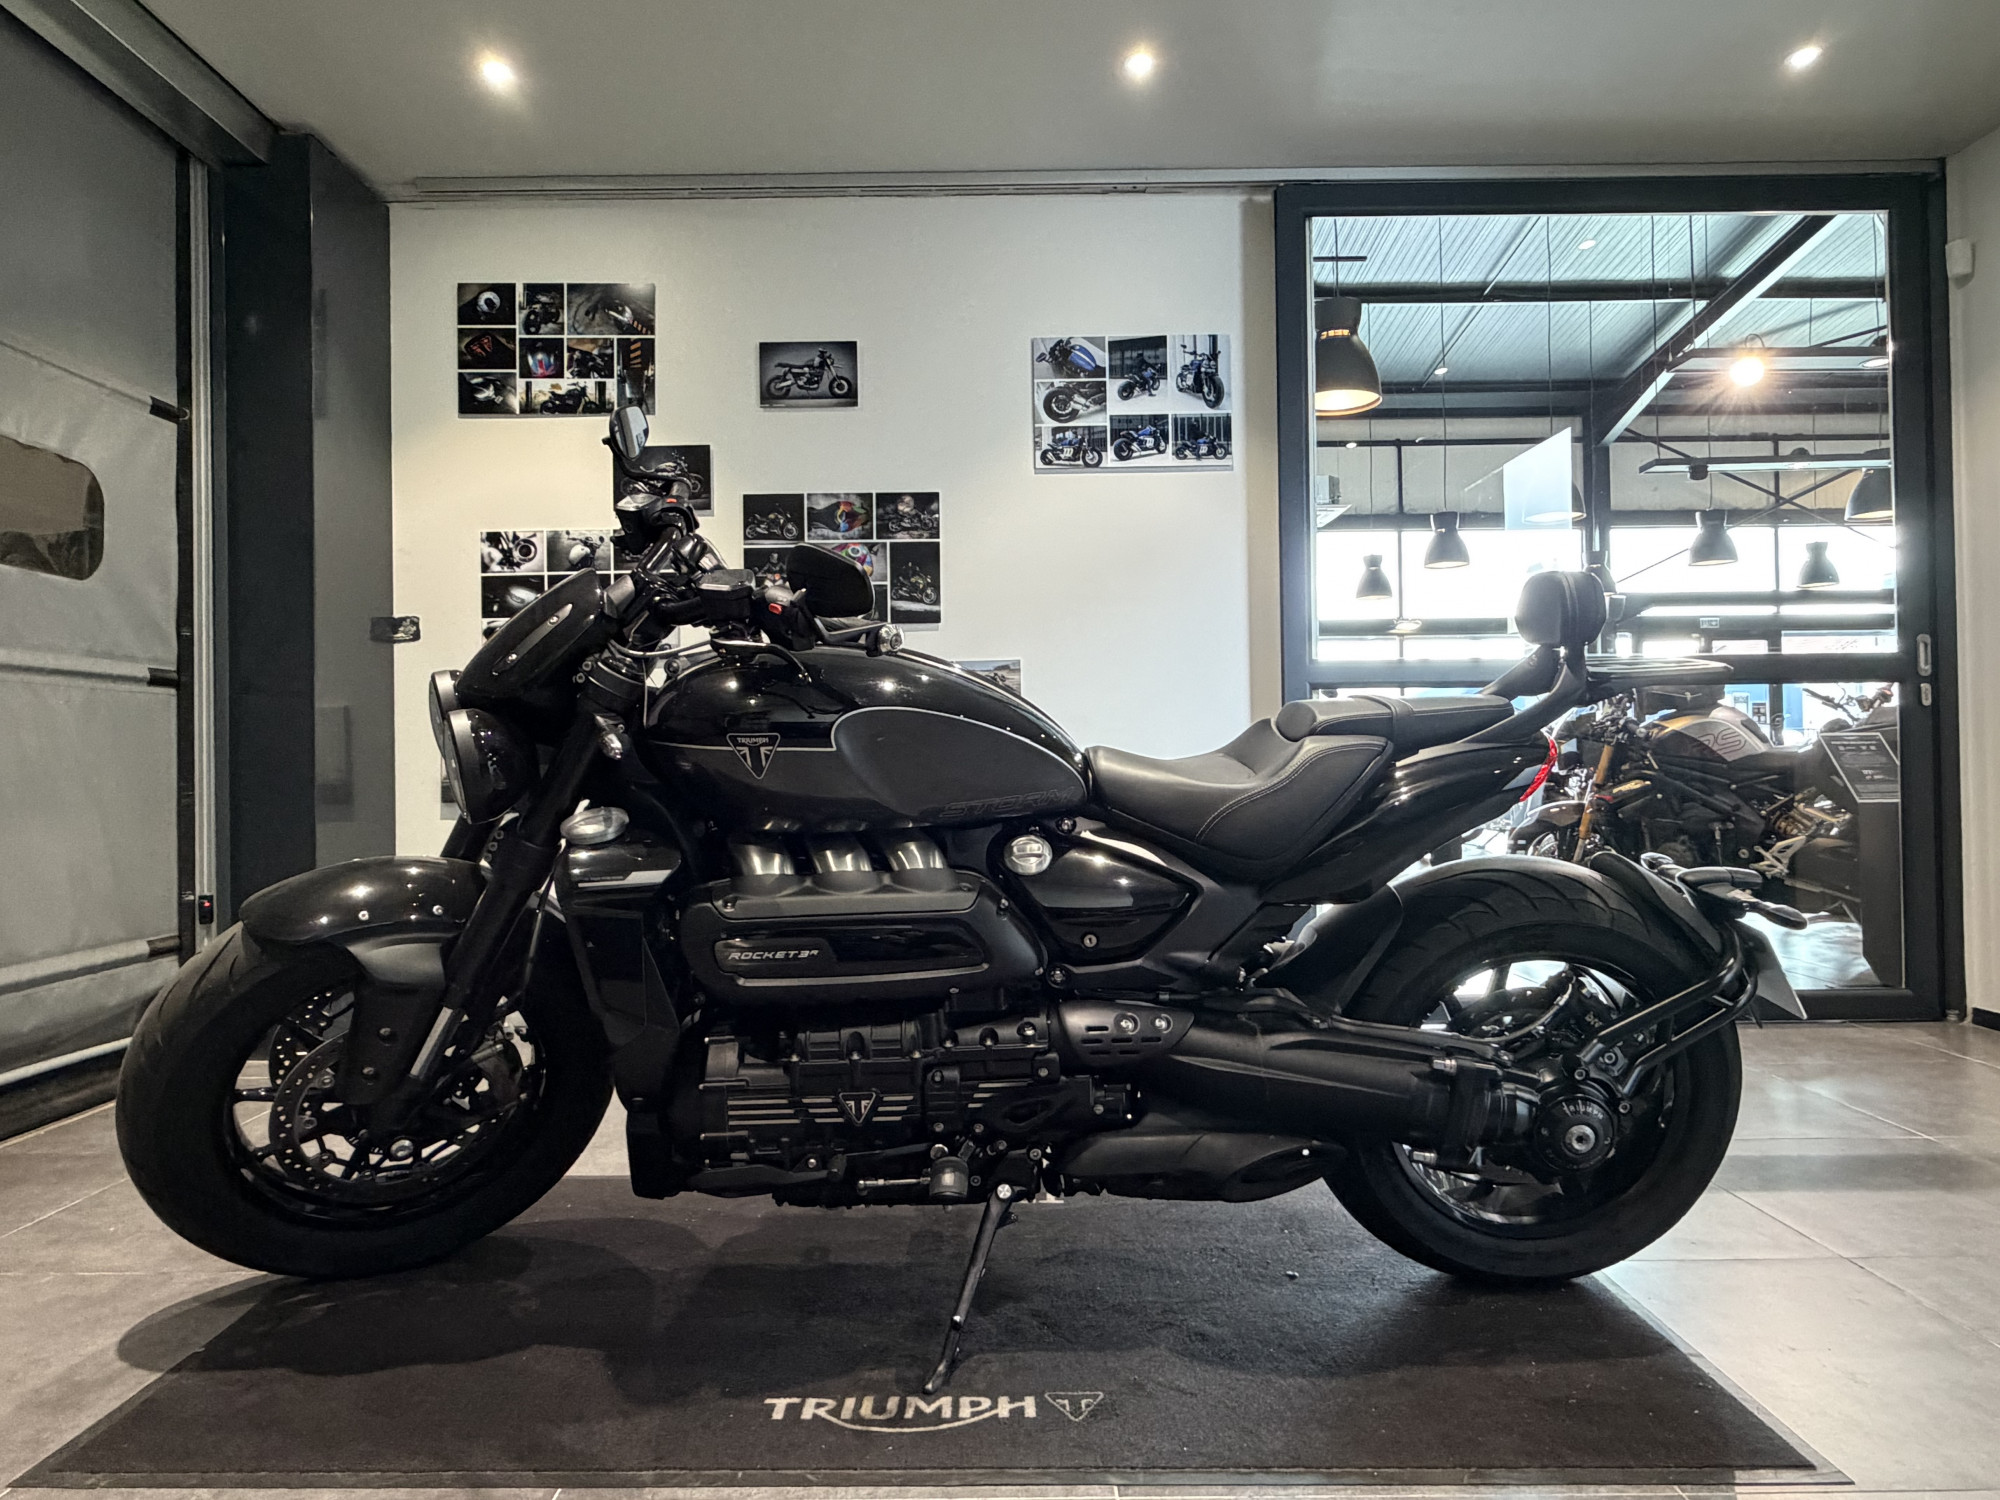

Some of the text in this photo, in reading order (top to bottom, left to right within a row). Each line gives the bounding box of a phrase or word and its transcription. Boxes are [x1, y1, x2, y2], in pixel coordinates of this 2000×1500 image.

[736, 737, 769, 746] TRIUMPH
[939, 786, 1076, 818] STORM
[764, 1396, 1037, 1432] TRIUMPH
